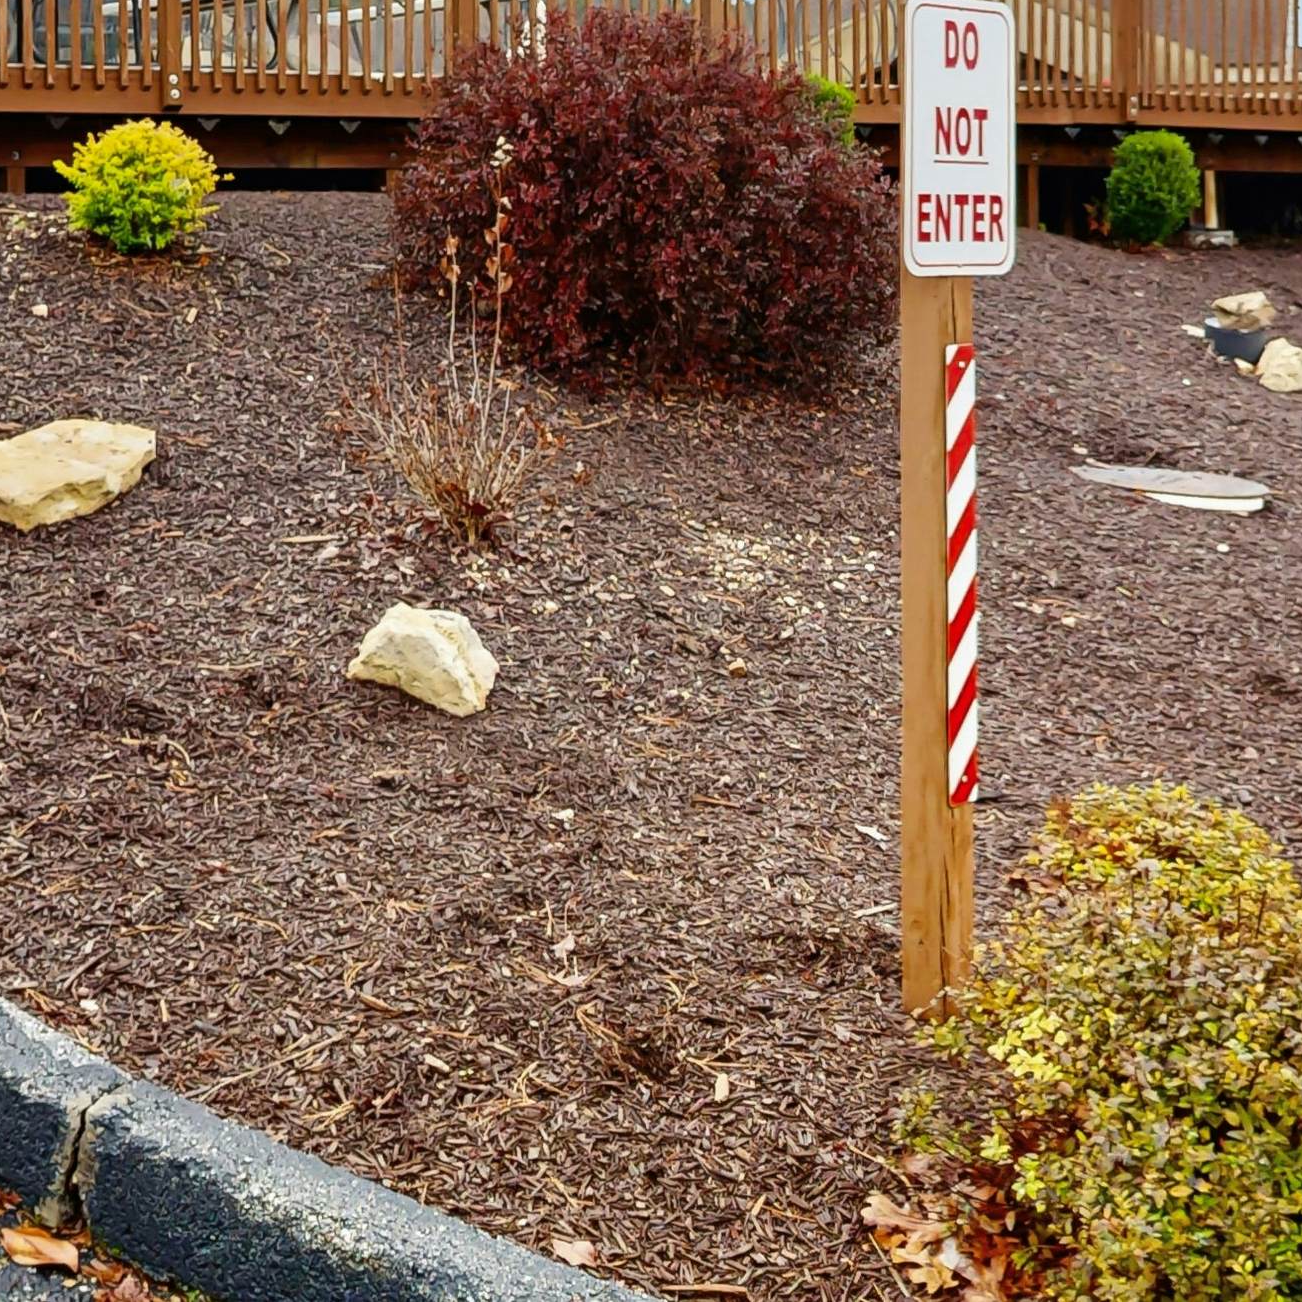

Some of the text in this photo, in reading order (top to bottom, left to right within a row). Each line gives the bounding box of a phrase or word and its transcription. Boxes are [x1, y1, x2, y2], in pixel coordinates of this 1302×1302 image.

[944, 20, 979, 70] DO
[935, 107, 988, 156] NOT
[916, 193, 1004, 242] ENTER
